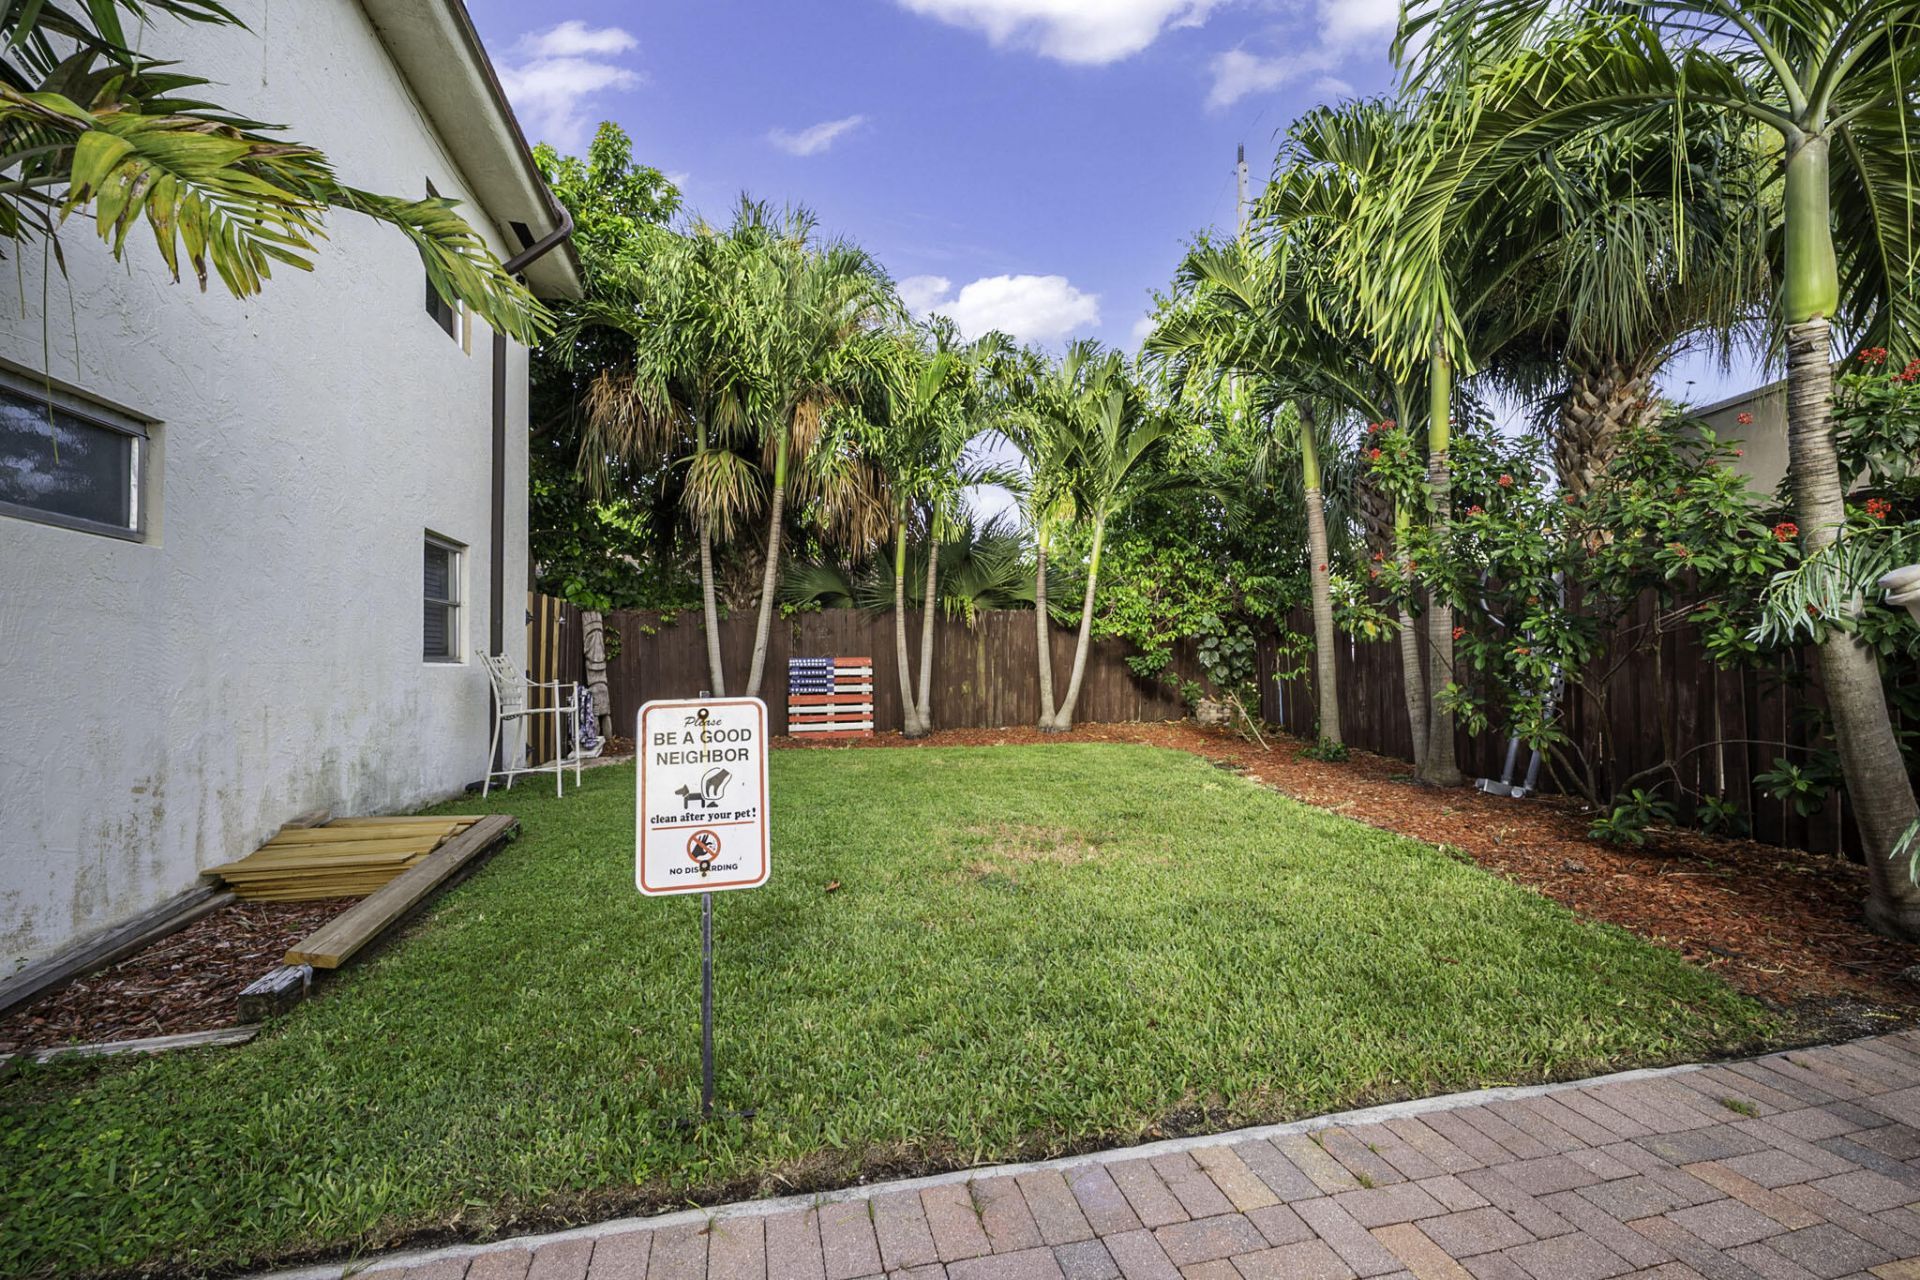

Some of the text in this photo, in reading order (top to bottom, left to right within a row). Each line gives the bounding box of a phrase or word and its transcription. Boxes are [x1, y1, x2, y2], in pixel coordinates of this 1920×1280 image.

[654, 728, 752, 746] BE A GOOD
[656, 748, 749, 766] NEIGHBOR
[650, 807, 757, 824] clean after your pet!
[669, 863, 738, 875] NO DISRDING
